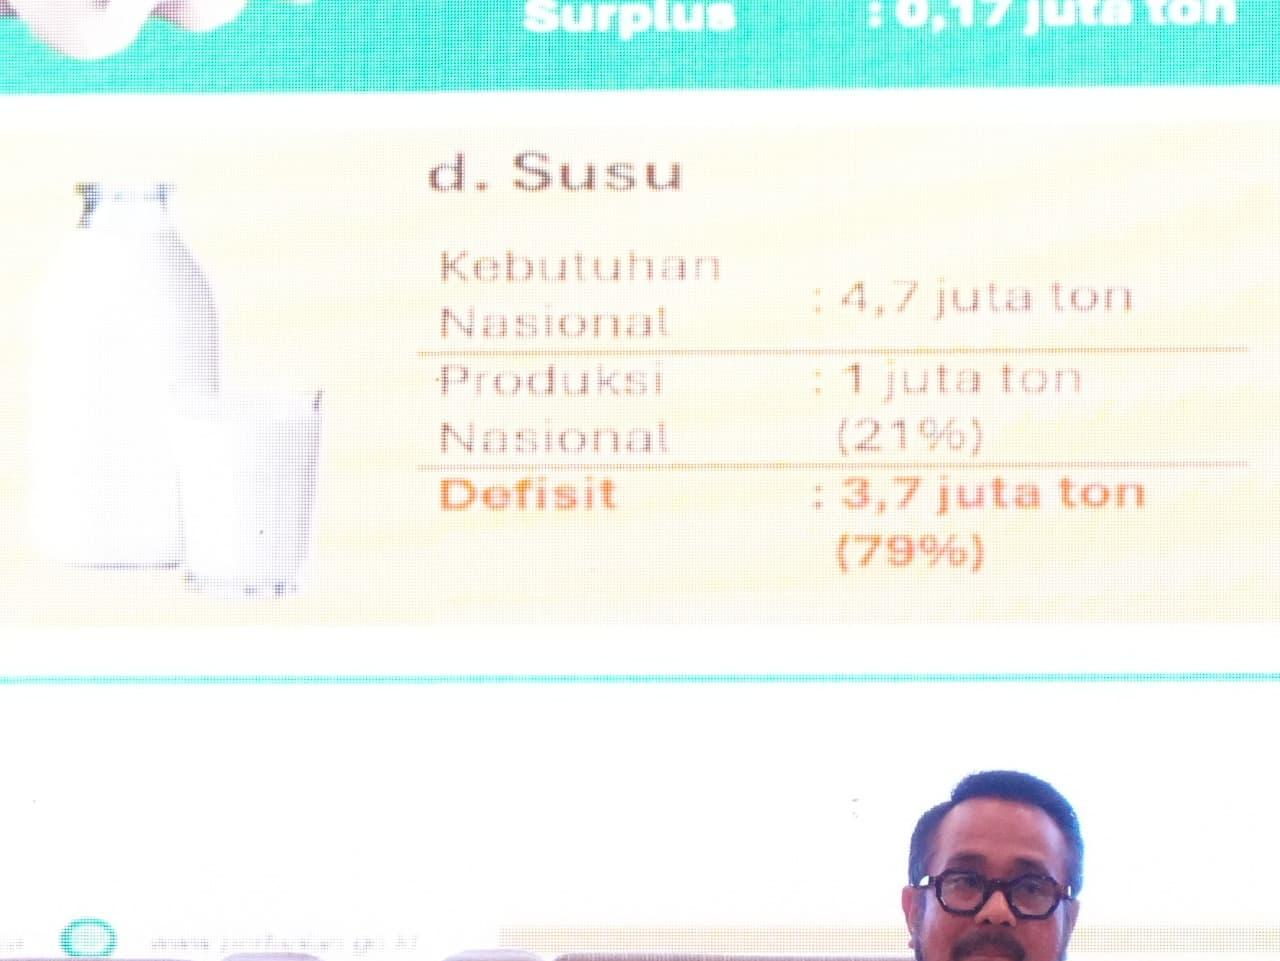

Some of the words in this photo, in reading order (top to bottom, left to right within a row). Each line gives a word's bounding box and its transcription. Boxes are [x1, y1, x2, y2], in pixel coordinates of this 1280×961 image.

[523, 0, 737, 41] Surplus
[895, 0, 1014, 33] 0,17
[1022, 0, 1132, 37] juta
[1147, 0, 1237, 25] ton
[428, 153, 487, 192] d.
[513, 153, 681, 193] Susu
[440, 249, 720, 284] Kebutuhan
[840, 280, 919, 318] 4,7
[934, 275, 1032, 321] juta
[1050, 281, 1133, 315] ton
[440, 306, 668, 340] Nasional
[440, 364, 663, 399] Produksi
[844, 362, 861, 395] 1
[881, 358, 982, 404] juta
[999, 361, 1081, 394] ton
[440, 419, 667, 454] Nasional
[838, 418, 983, 460] (21%)
[440, 477, 616, 512] Defisit
[842, 475, 923, 515] 3,7
[937, 475, 1040, 516] juta
[1059, 477, 1146, 510] ton
[836, 532, 984, 574] (79%)
